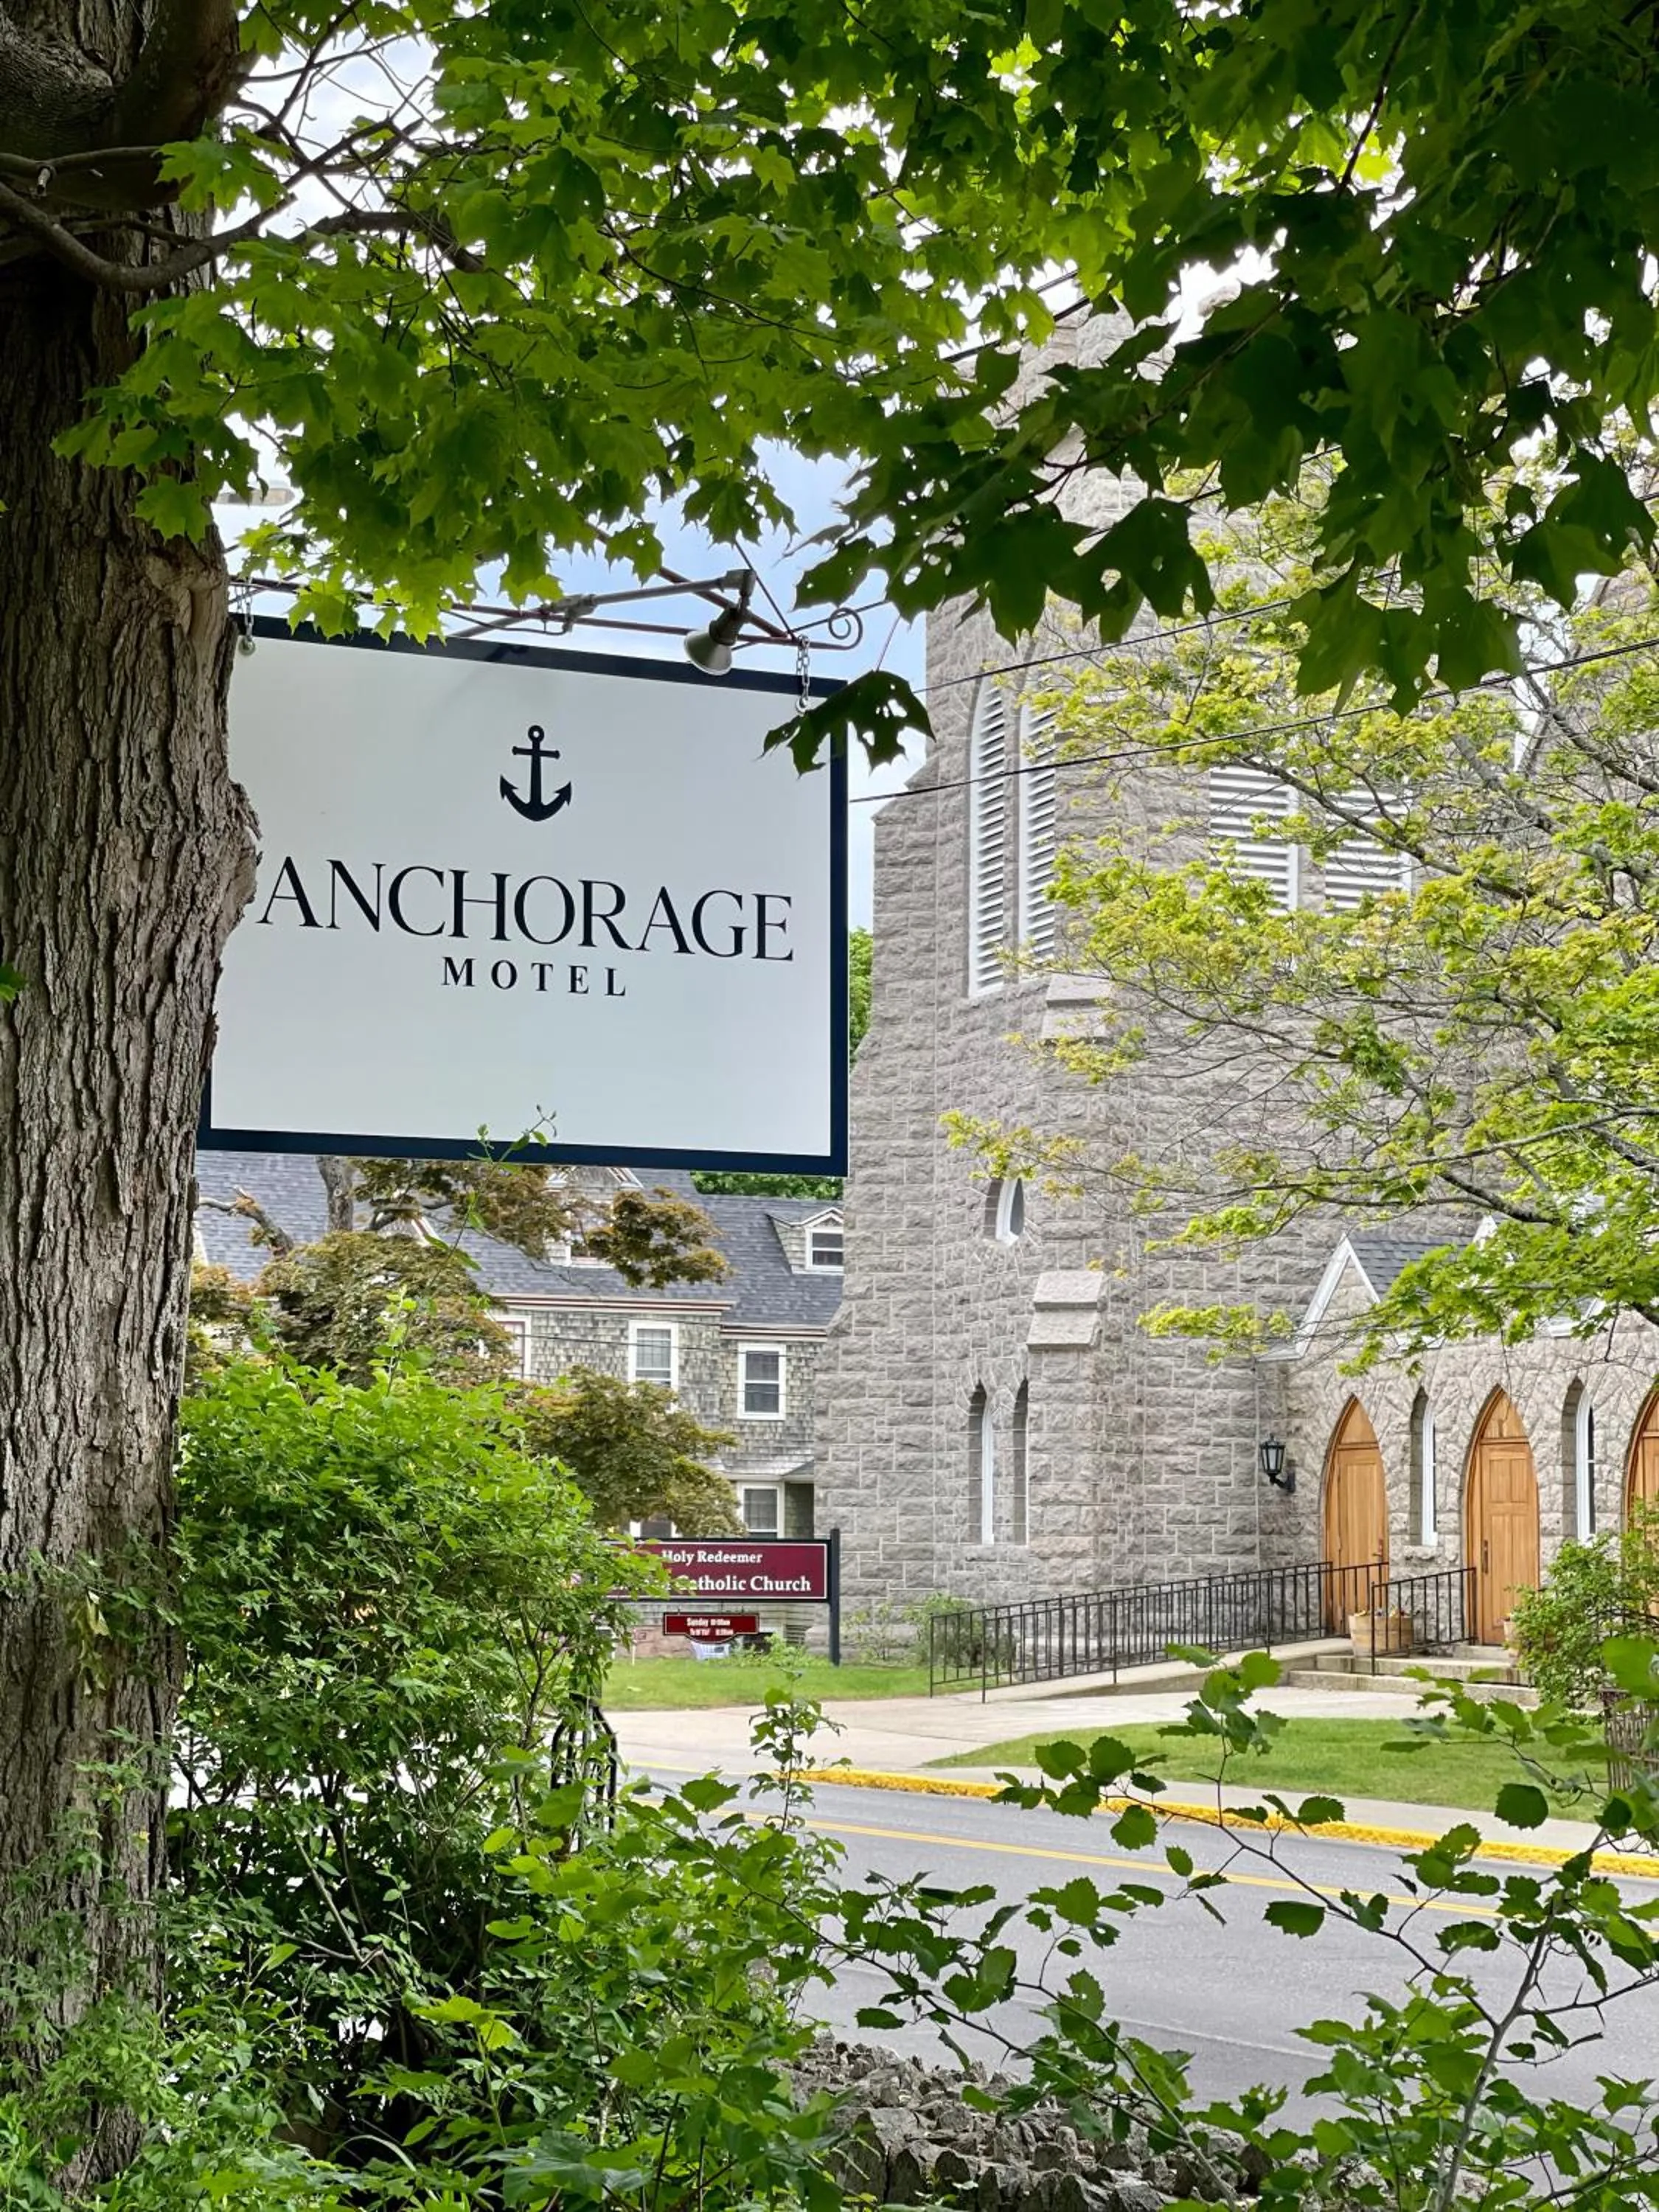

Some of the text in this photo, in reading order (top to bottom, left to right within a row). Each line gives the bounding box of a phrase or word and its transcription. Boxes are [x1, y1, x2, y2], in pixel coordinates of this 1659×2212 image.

[257, 856, 793, 961] ANCHORAGE
[442, 957, 627, 997] MOTEL
[661, 1550, 762, 1566] Holy Redeemer
[750, 1576, 811, 1592] Church
